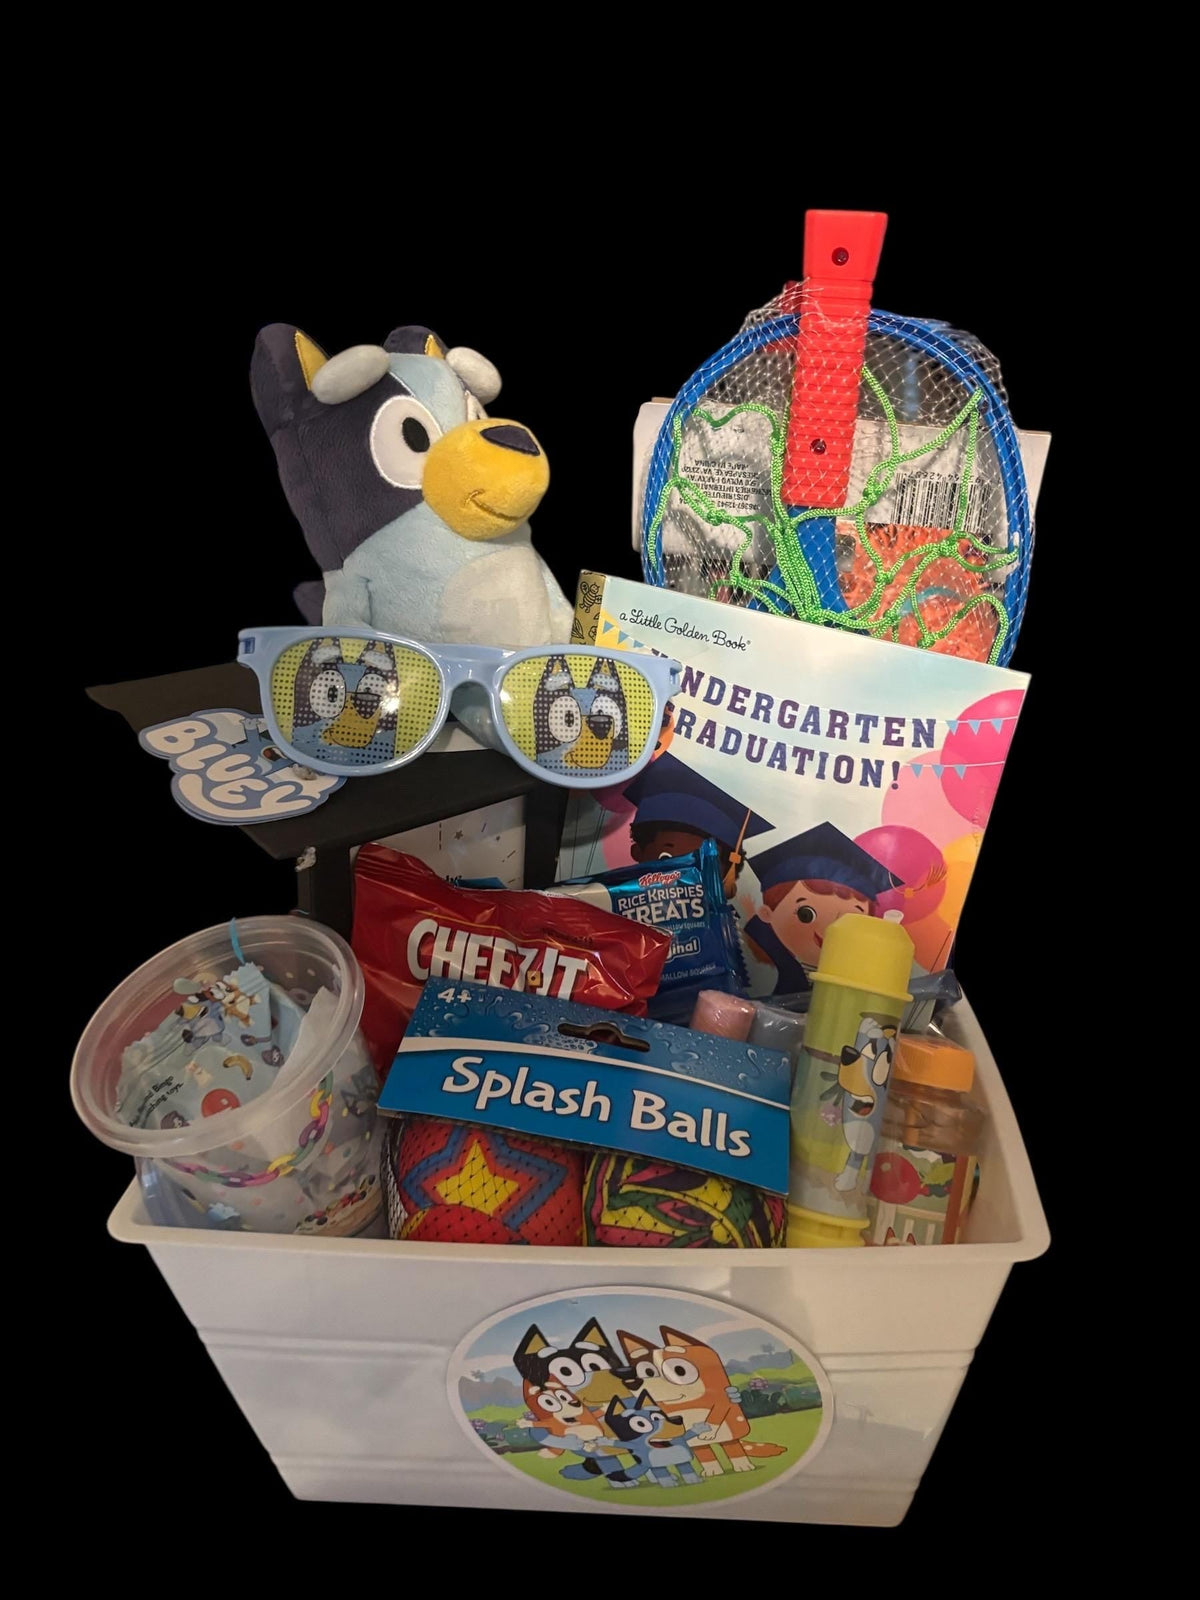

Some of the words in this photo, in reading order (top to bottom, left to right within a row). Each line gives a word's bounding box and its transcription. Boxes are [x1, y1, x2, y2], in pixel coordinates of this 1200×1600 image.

[619, 611, 628, 621] a
[630, 608, 662, 630] Little
[664, 617, 710, 642] Golden
[651, 648, 937, 749] NDERGARTEN
[639, 870, 680, 886] Kellogg's
[618, 893, 646, 911] RICE
[647, 884, 704, 902] KRISPIES
[621, 898, 705, 924] TREATS
[437, 987, 473, 1004] 4+
[442, 1055, 612, 1123] Splash
[630, 1089, 752, 1159] Balls
